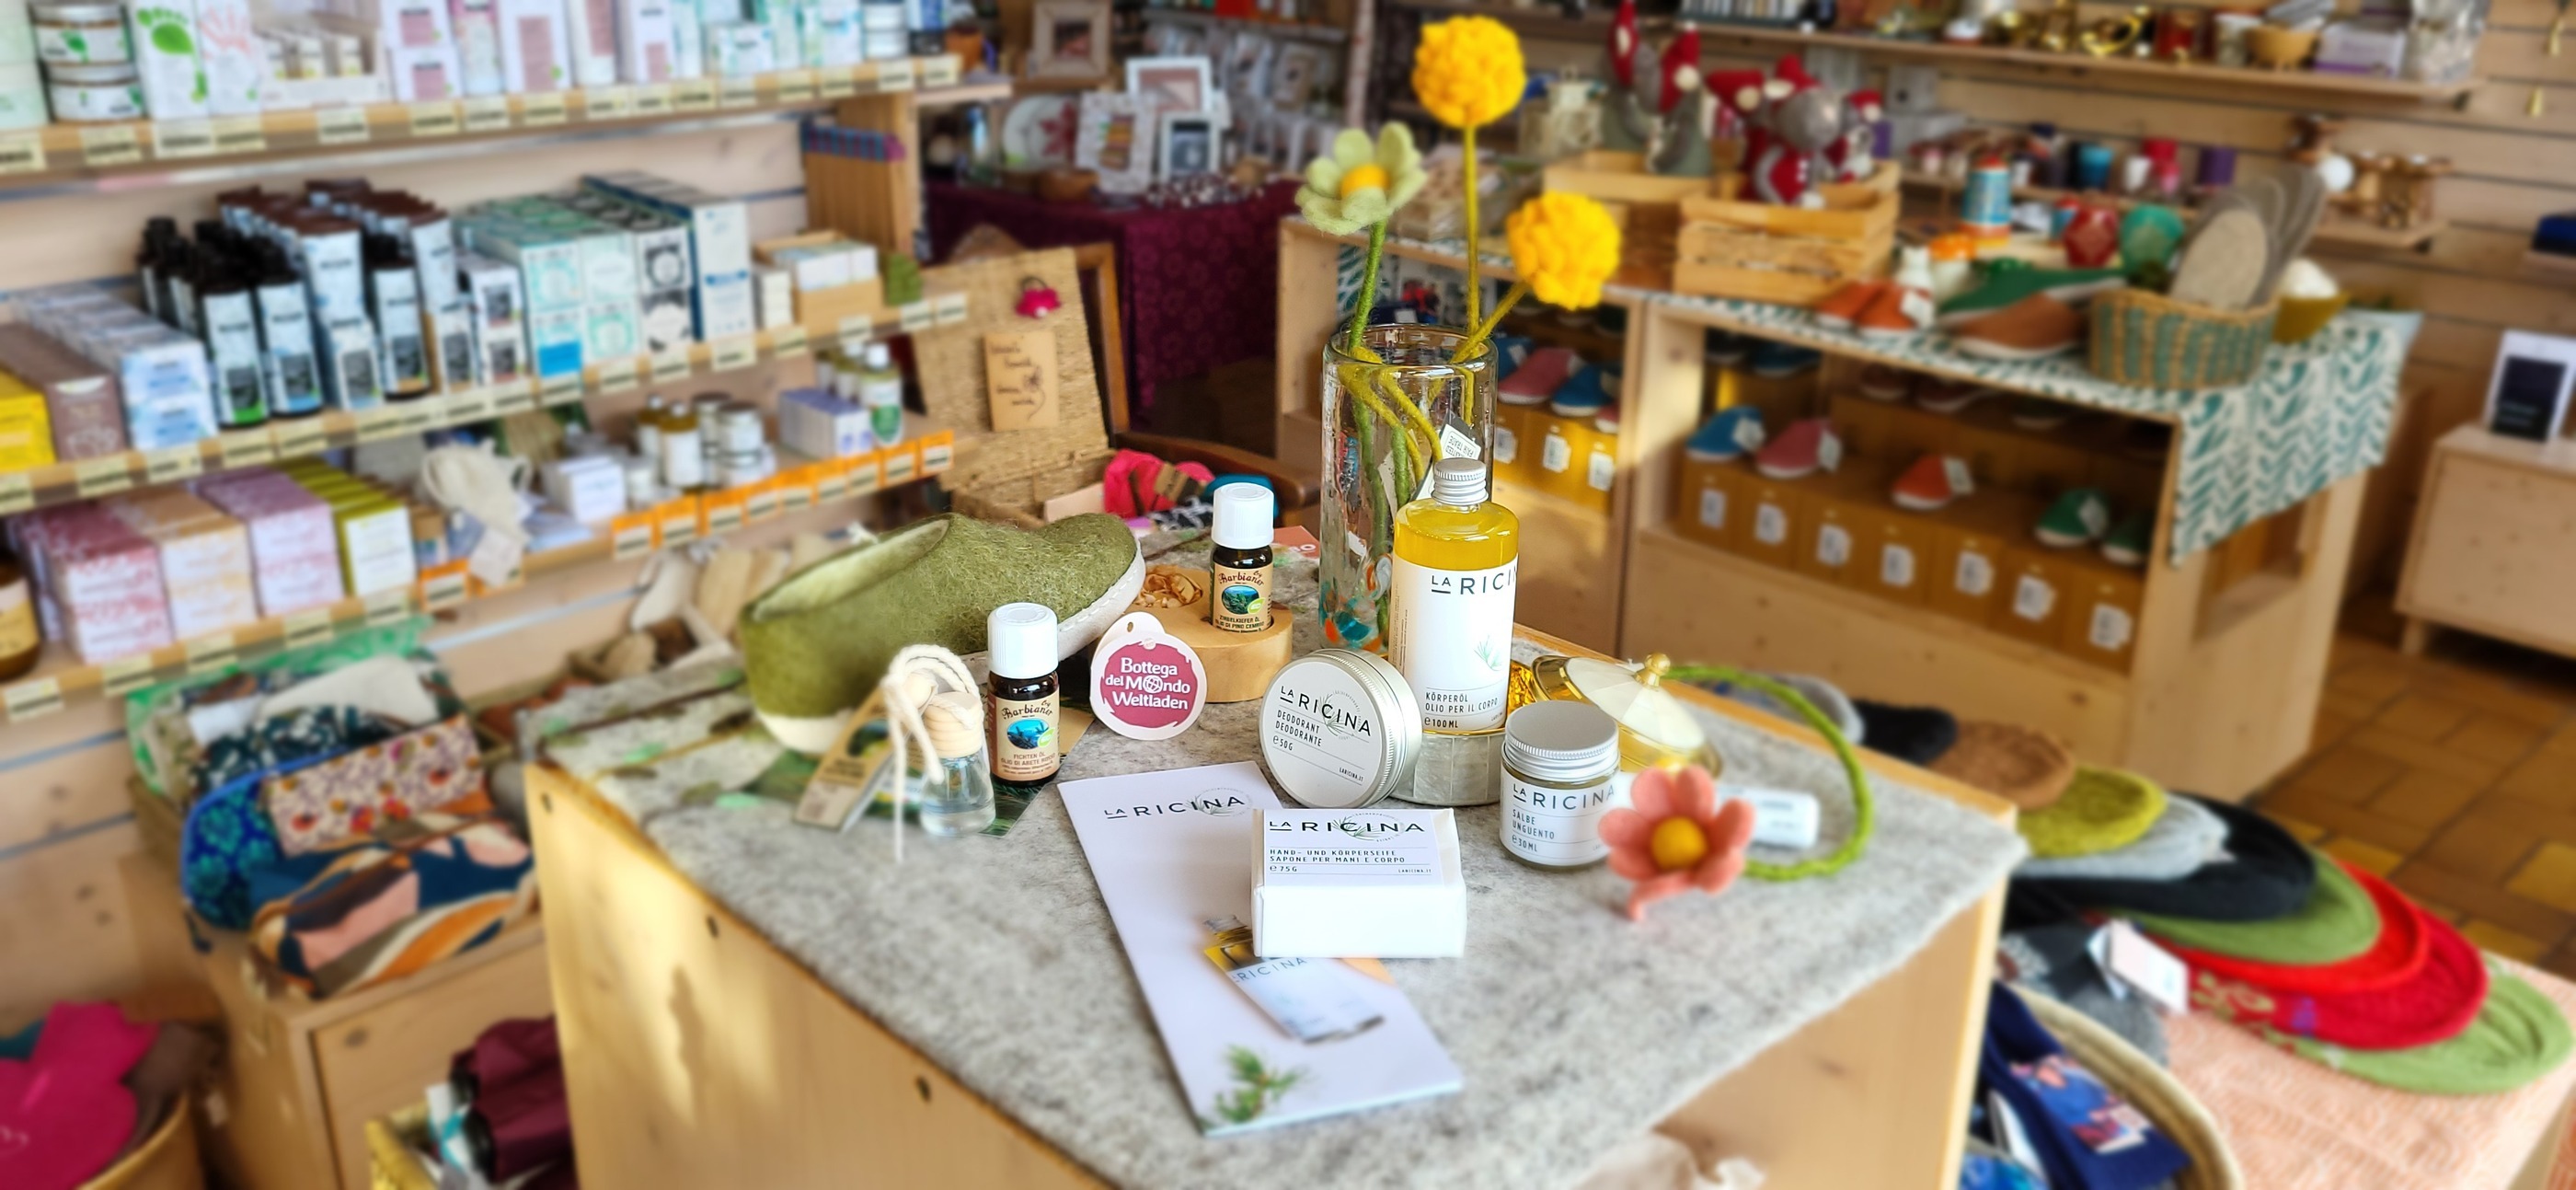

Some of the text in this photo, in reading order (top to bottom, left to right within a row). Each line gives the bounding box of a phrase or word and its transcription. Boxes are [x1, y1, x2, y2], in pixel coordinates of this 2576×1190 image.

[1432, 575, 1451, 586] LA
[1121, 657, 1178, 677] Bottega
[1106, 675, 1190, 694] del Mondo
[1112, 691, 1188, 710] Weltladen
[1426, 692, 1468, 702] KÖRPERÖL
[1426, 698, 1498, 713] OLIO PER IL CORPO
[1281, 686, 1294, 698] LA
[1299, 694, 1371, 736] RICINA
[1278, 711, 1320, 734] DEODORANT
[1276, 721, 1322, 746] DEODORANTE
[1133, 796, 1246, 816] RICINA
[1513, 784, 1615, 810] LA RICINA
[1302, 822, 1425, 832] RICINA
[1512, 809, 1535, 826] SALBE
[1512, 820, 1555, 840] UNGUENTO
[1236, 957, 1307, 981] RICINA
